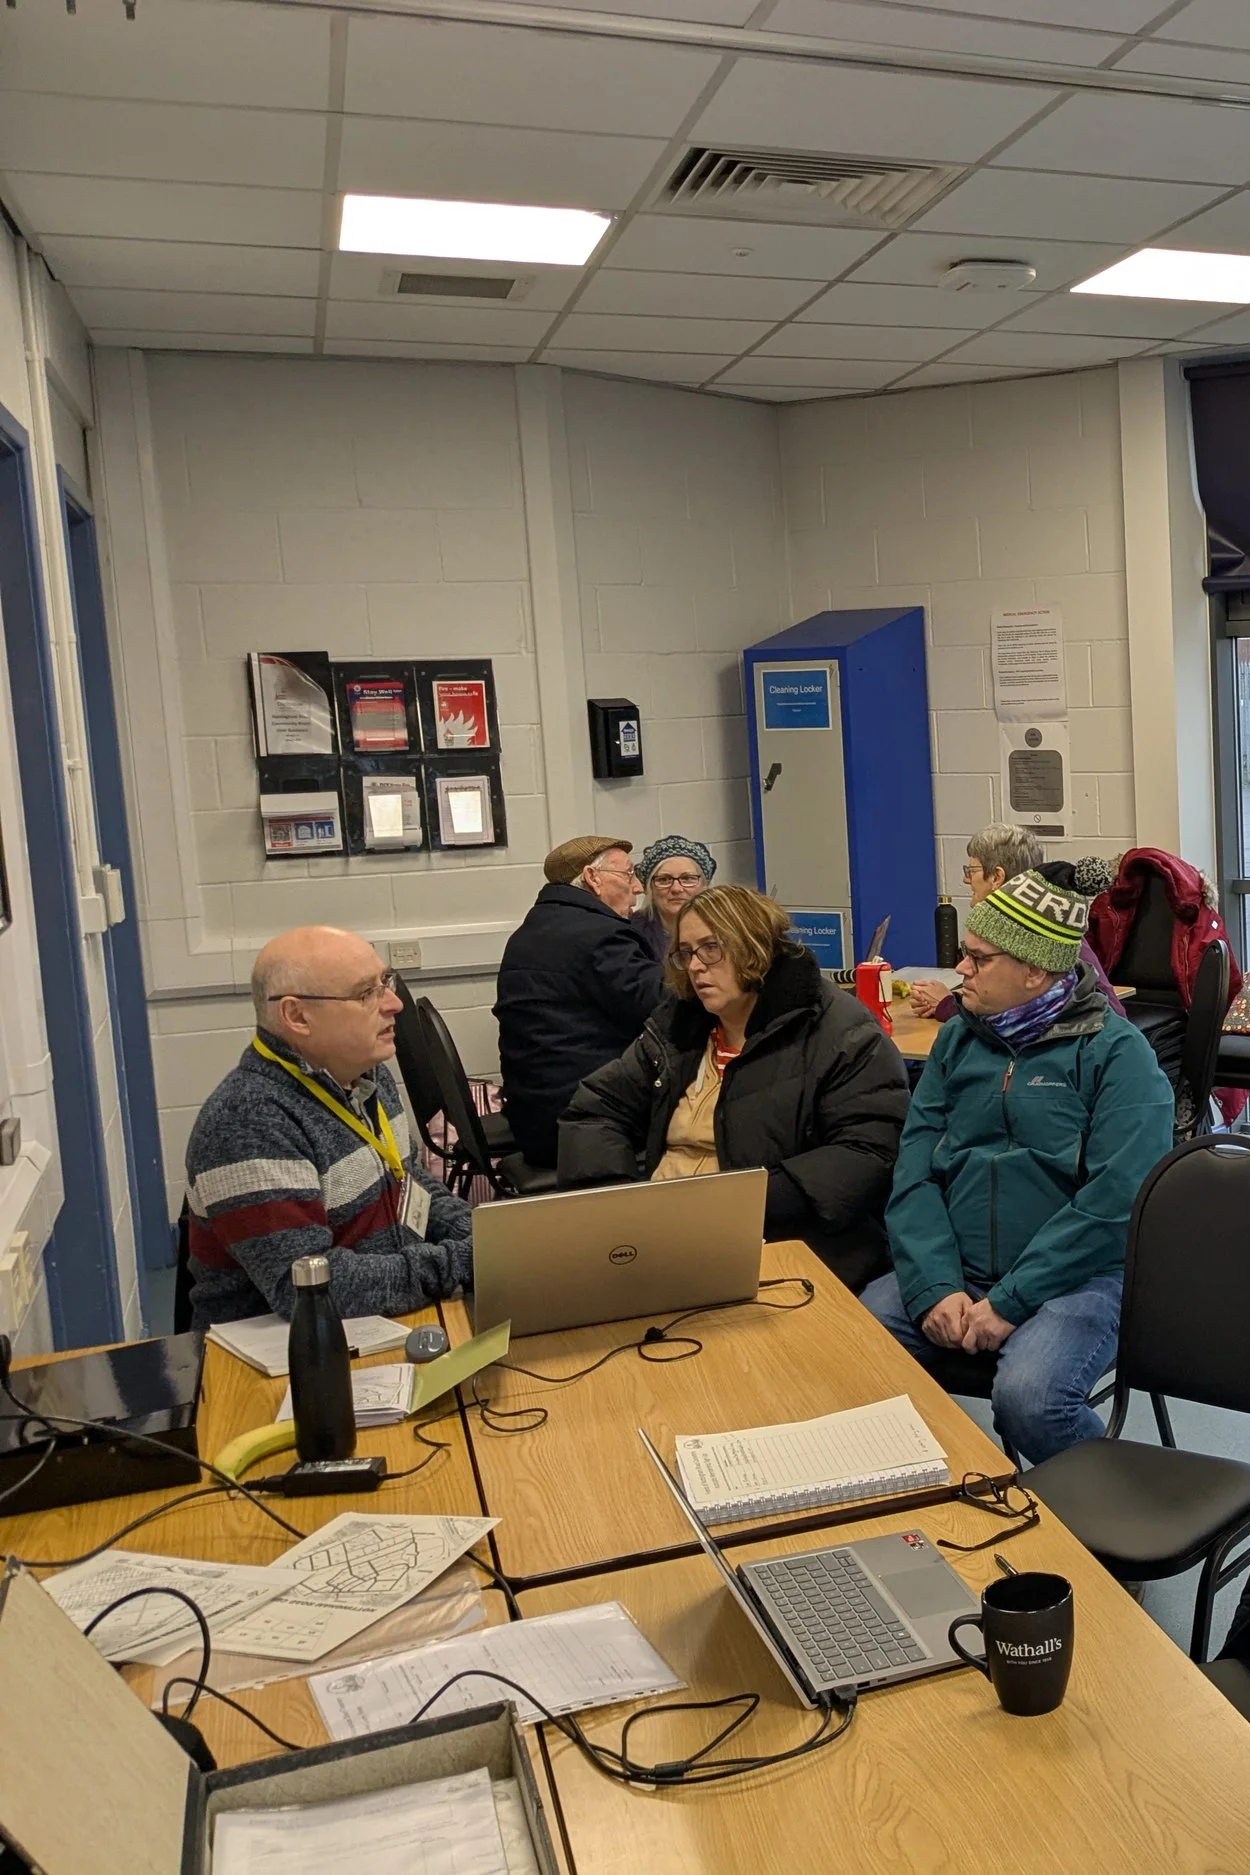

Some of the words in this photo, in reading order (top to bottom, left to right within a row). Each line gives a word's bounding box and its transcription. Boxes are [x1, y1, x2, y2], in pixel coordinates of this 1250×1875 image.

[769, 685, 799, 695] Cleaning
[800, 685, 823, 693] Locker
[813, 927, 837, 935] Locker
[612, 1251, 635, 1259] DELL
[996, 1638, 1062, 1657] Wathall's
